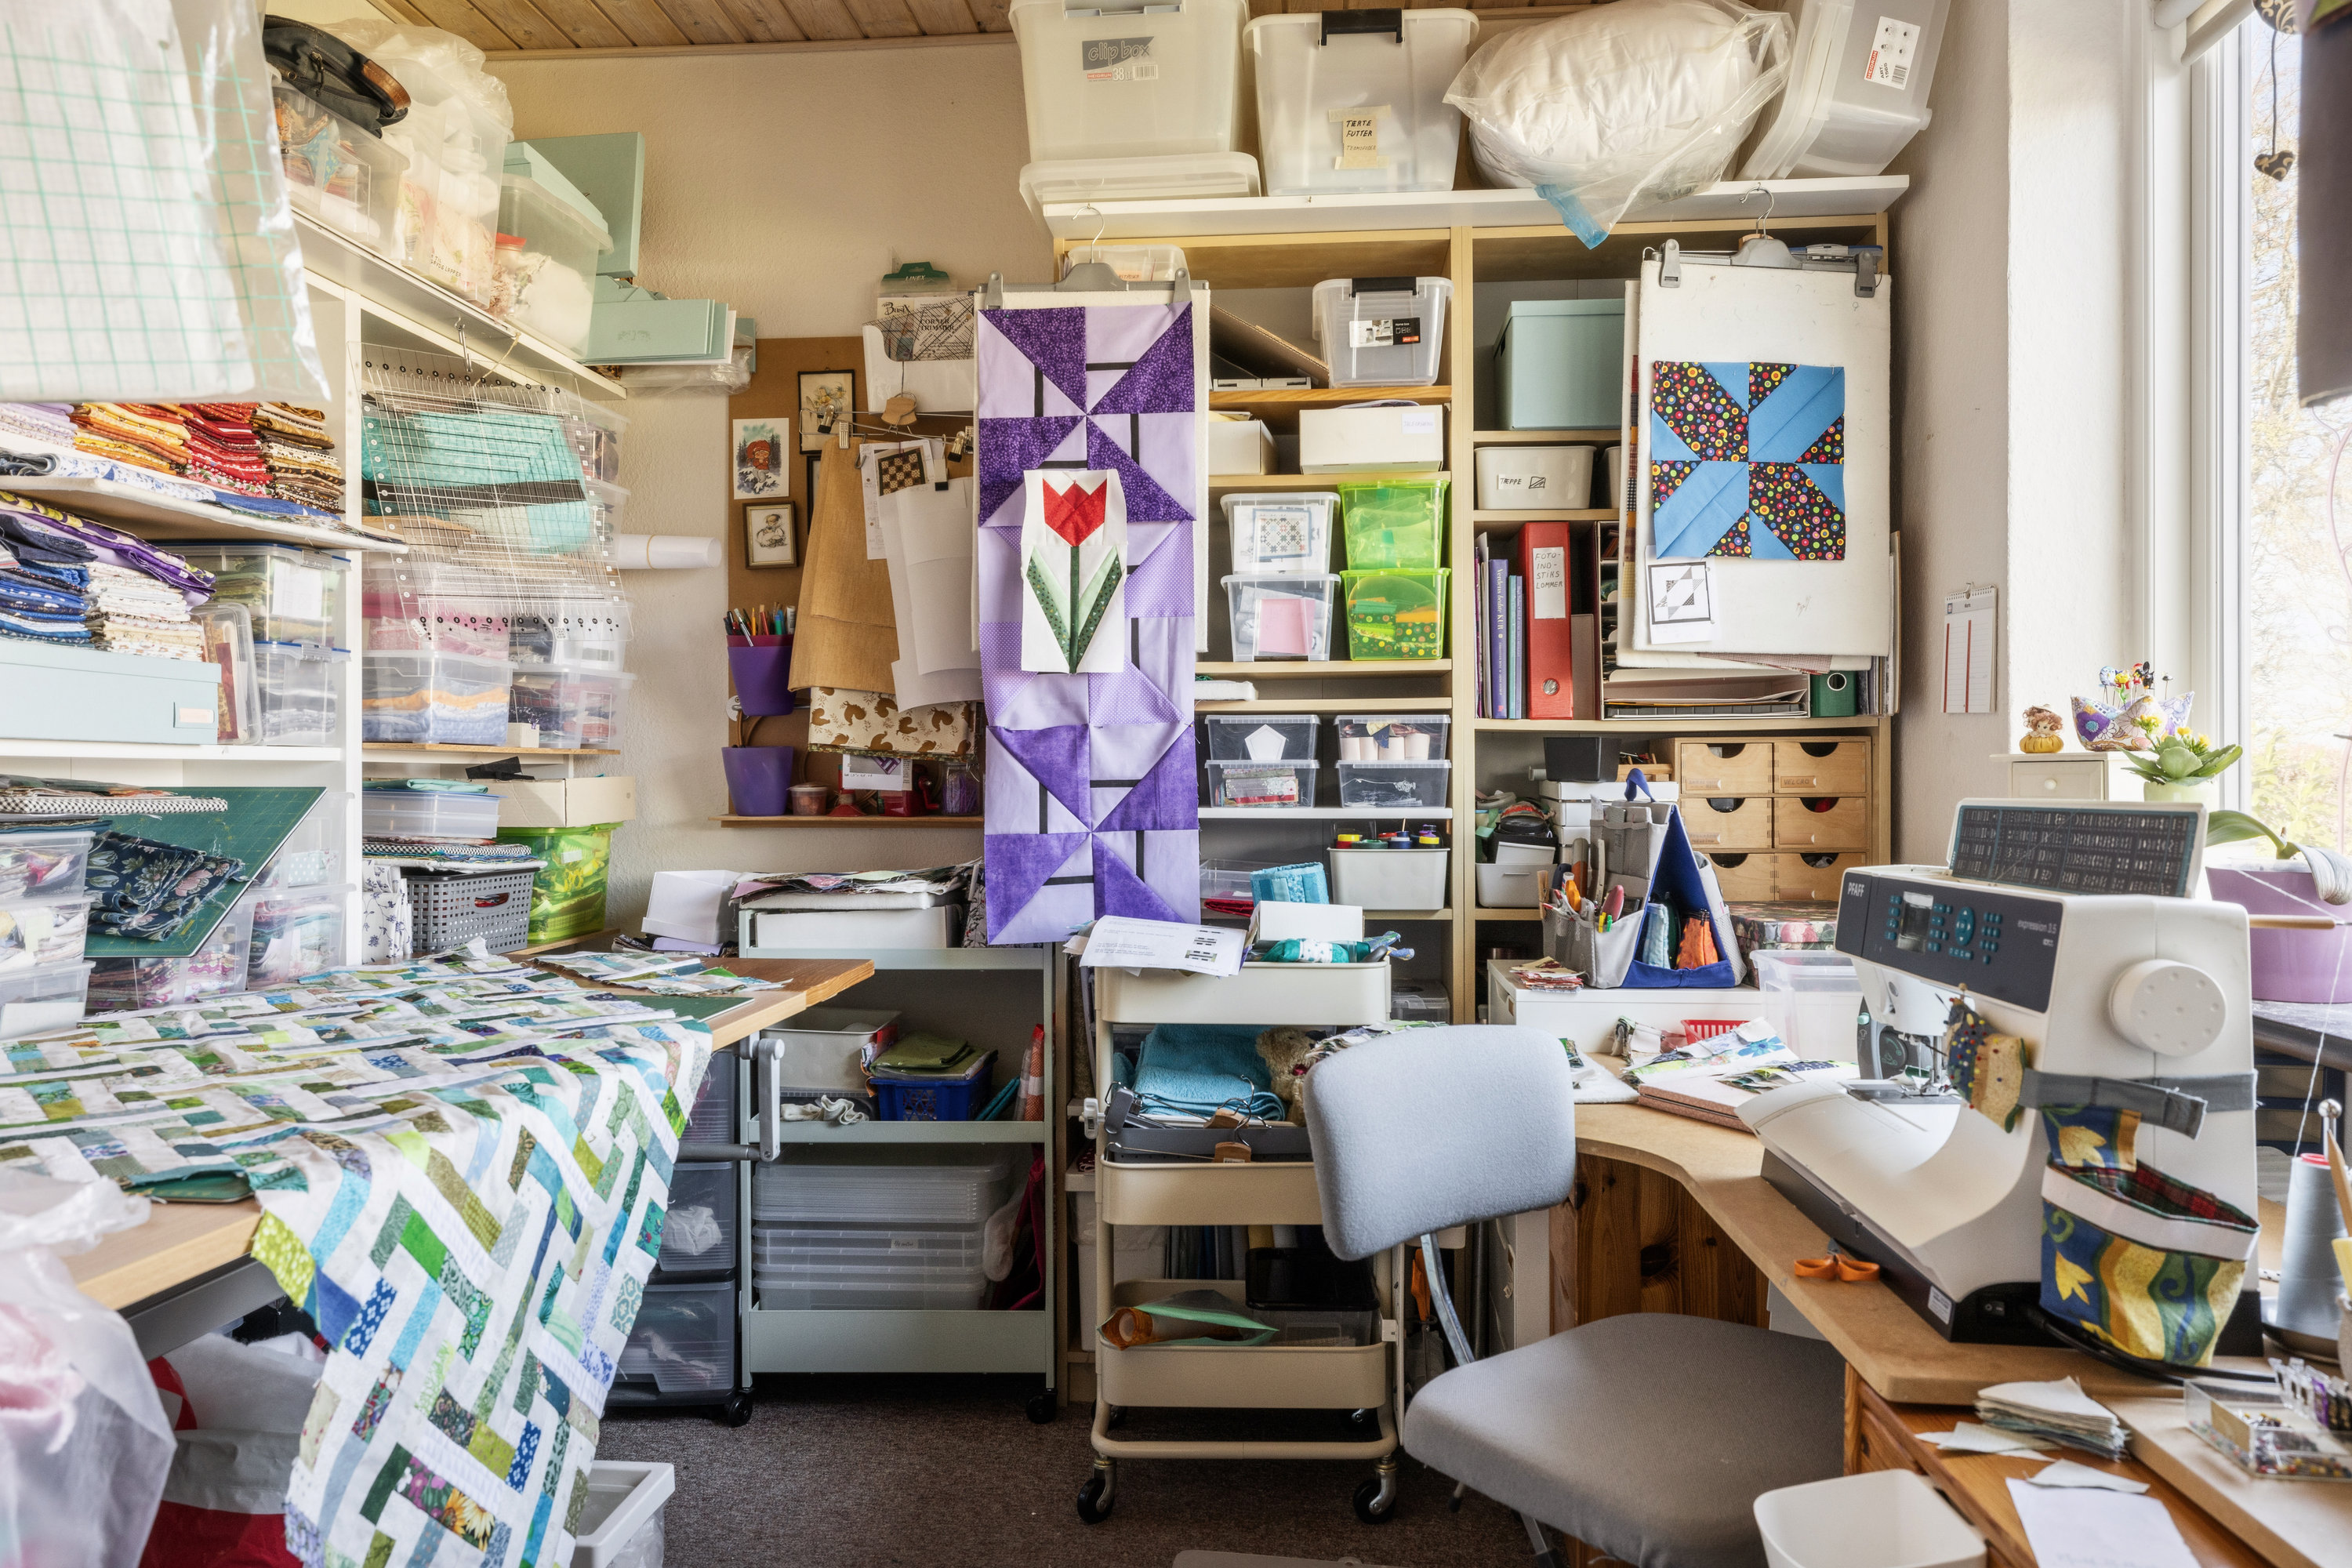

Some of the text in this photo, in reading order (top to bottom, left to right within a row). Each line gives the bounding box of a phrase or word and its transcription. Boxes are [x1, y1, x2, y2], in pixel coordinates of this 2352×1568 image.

[1088, 40, 1150, 66] clip box
[1112, 67, 1125, 81] 38
[1866, 50, 1878, 78] HEIDRUN
[1847, 881, 1864, 898] PFAFF
